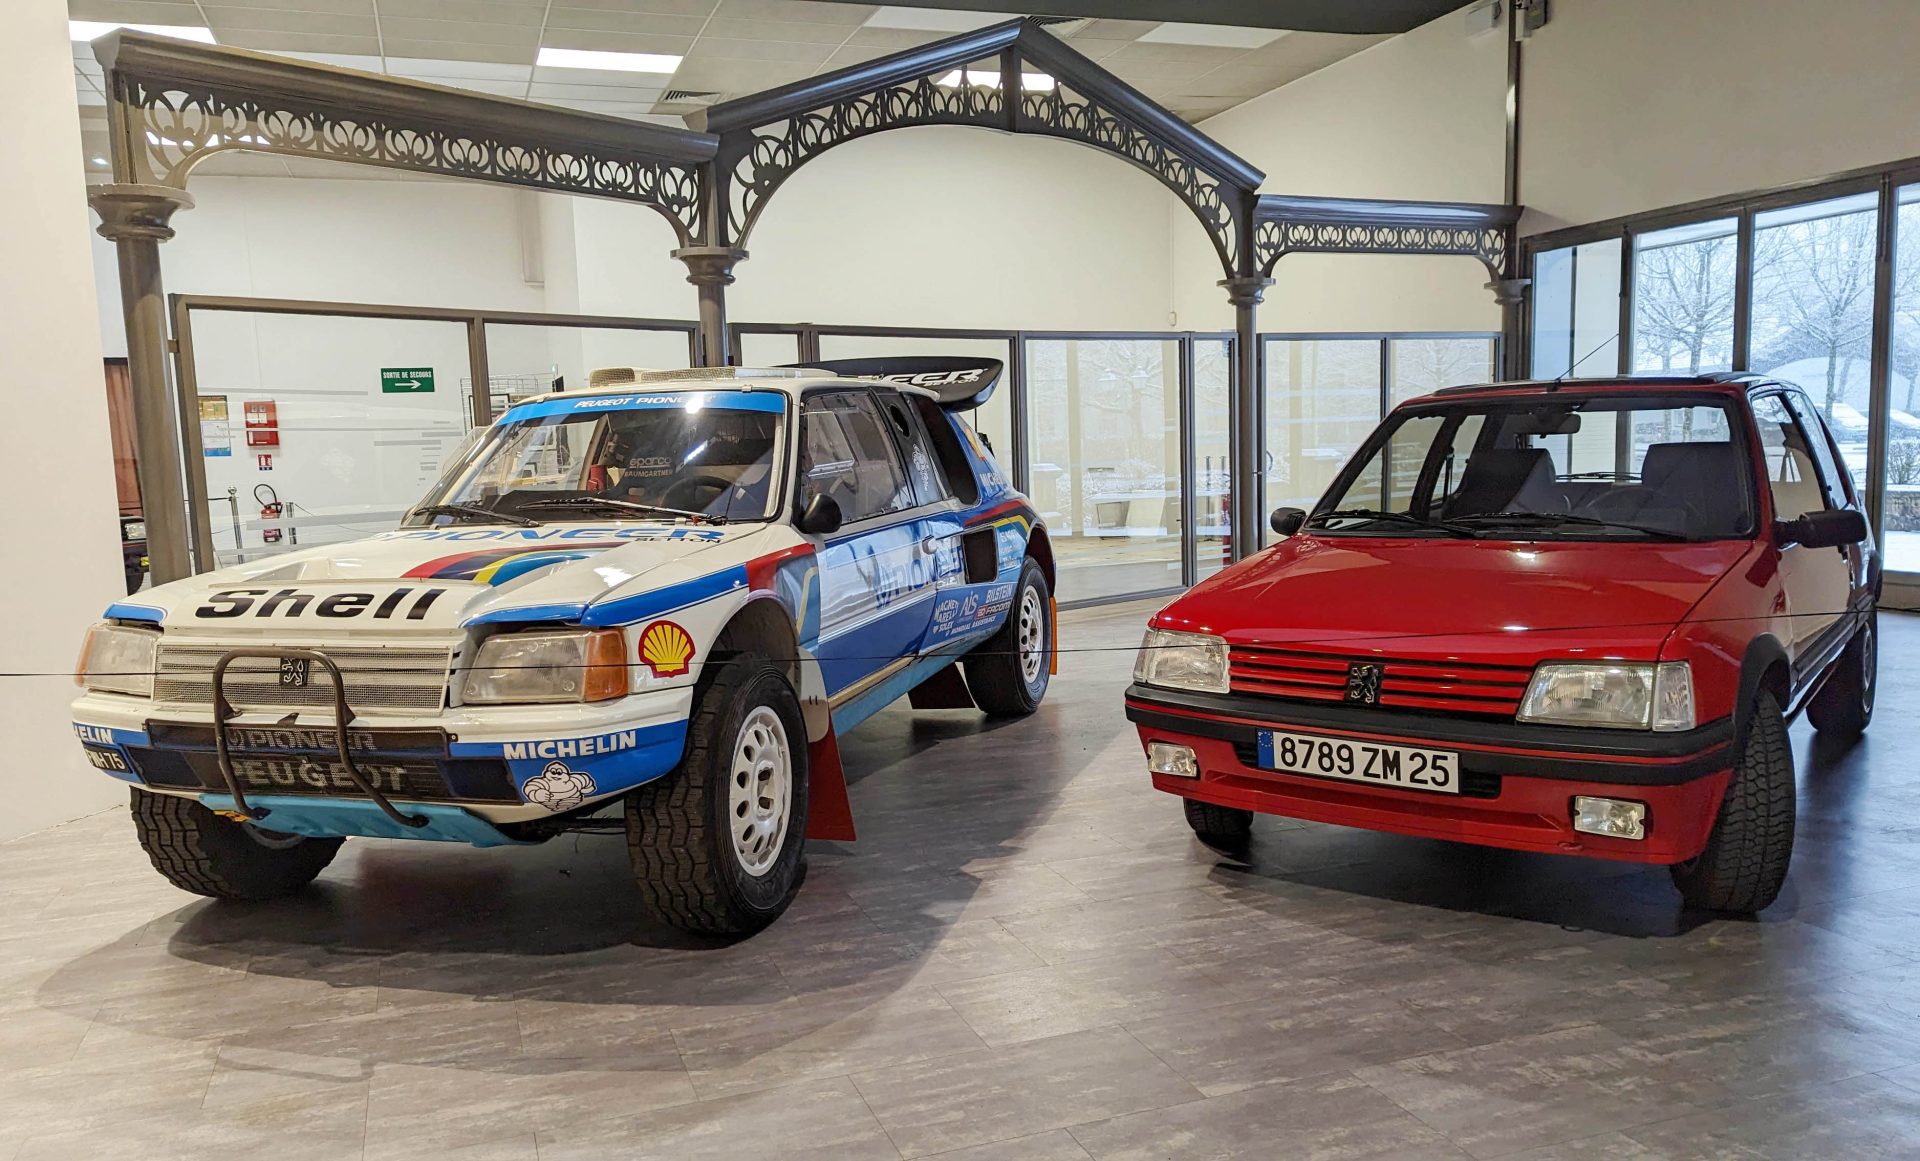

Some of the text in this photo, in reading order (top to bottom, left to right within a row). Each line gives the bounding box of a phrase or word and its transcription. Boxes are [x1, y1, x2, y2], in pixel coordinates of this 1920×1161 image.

[382, 370, 432, 379] SORTIE DE SECOURS
[574, 397, 634, 409] PEUGEOT
[629, 456, 672, 469] sparco
[382, 527, 726, 541] PIONEER
[195, 588, 448, 620] Shell
[502, 730, 637, 760] MICHELIN
[1280, 736, 1450, 787] 8789 ZM 25
